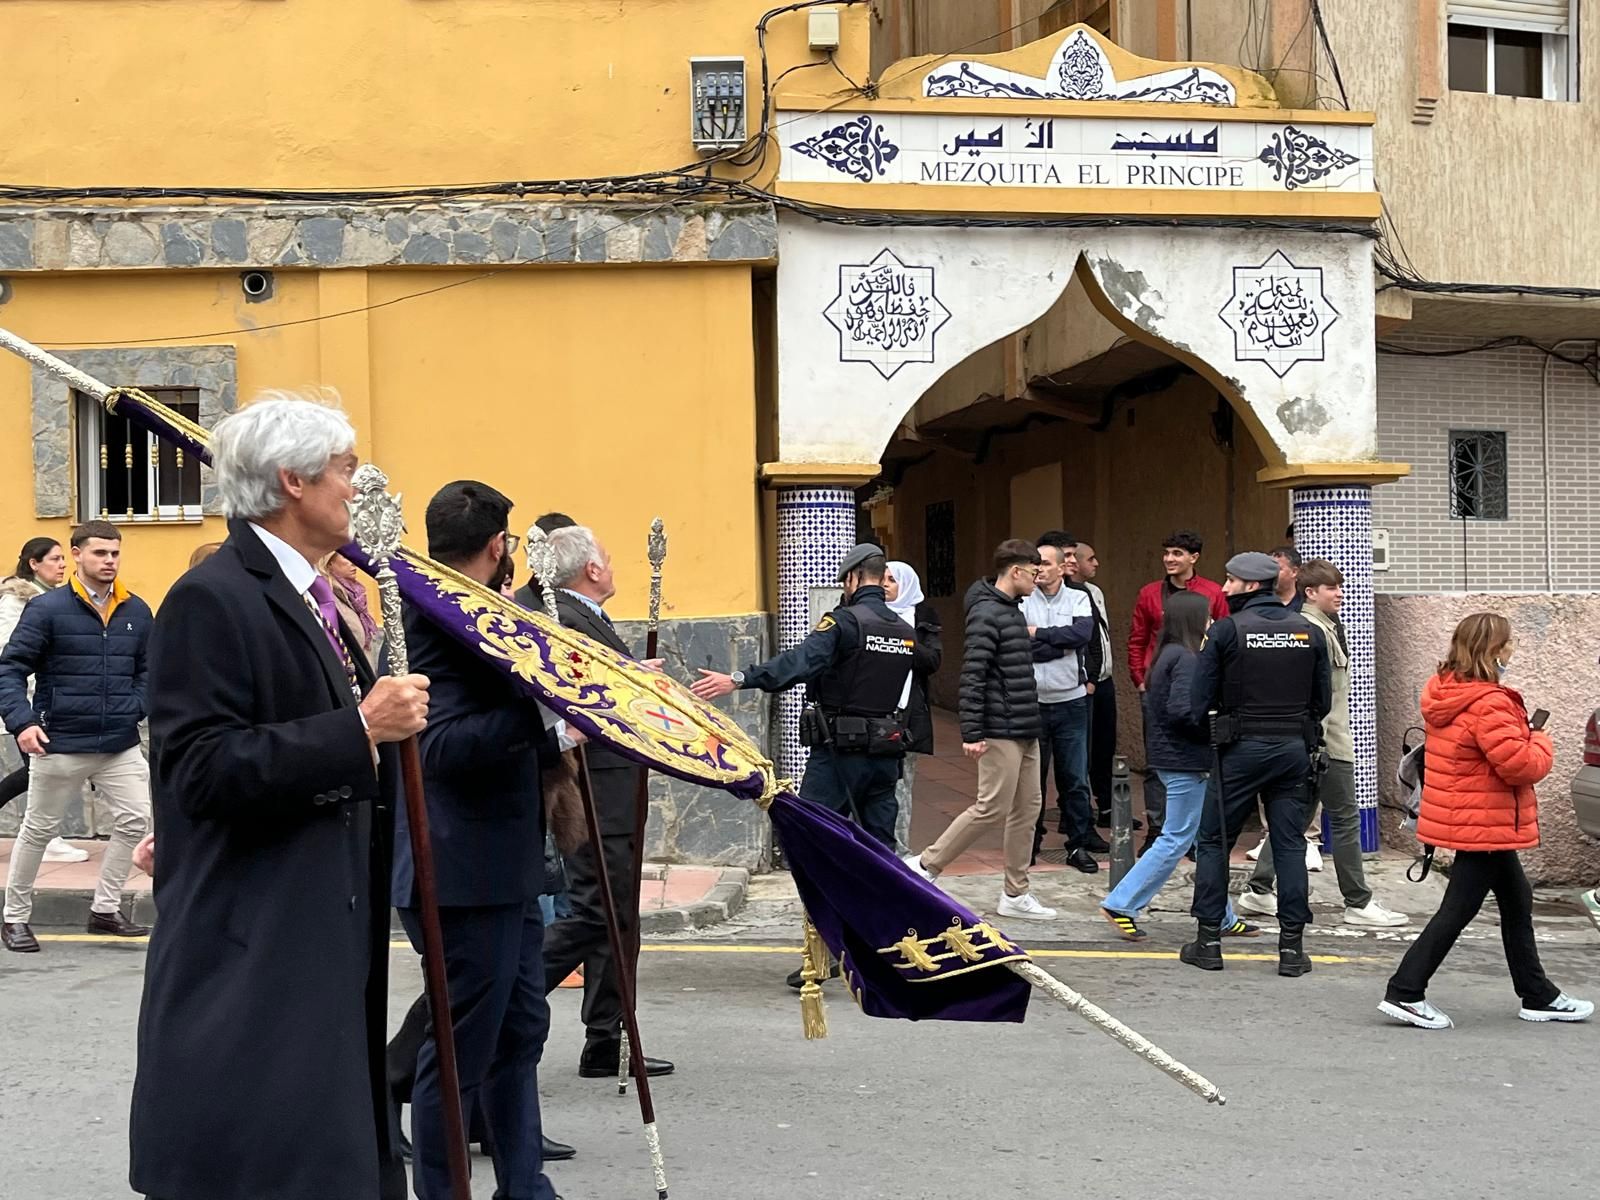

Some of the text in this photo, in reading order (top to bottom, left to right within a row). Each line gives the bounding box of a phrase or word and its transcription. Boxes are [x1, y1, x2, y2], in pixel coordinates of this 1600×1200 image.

[1110, 124, 1219, 160] مسجد
[920, 161, 1244, 187] MEZQUITA EL PRINCIPE
[866, 635, 906, 647] POLICIA
[1246, 633, 1297, 641] POLICIA
[866, 643, 914, 655] NACIONAL
[1246, 640, 1310, 649] NACIONAL
